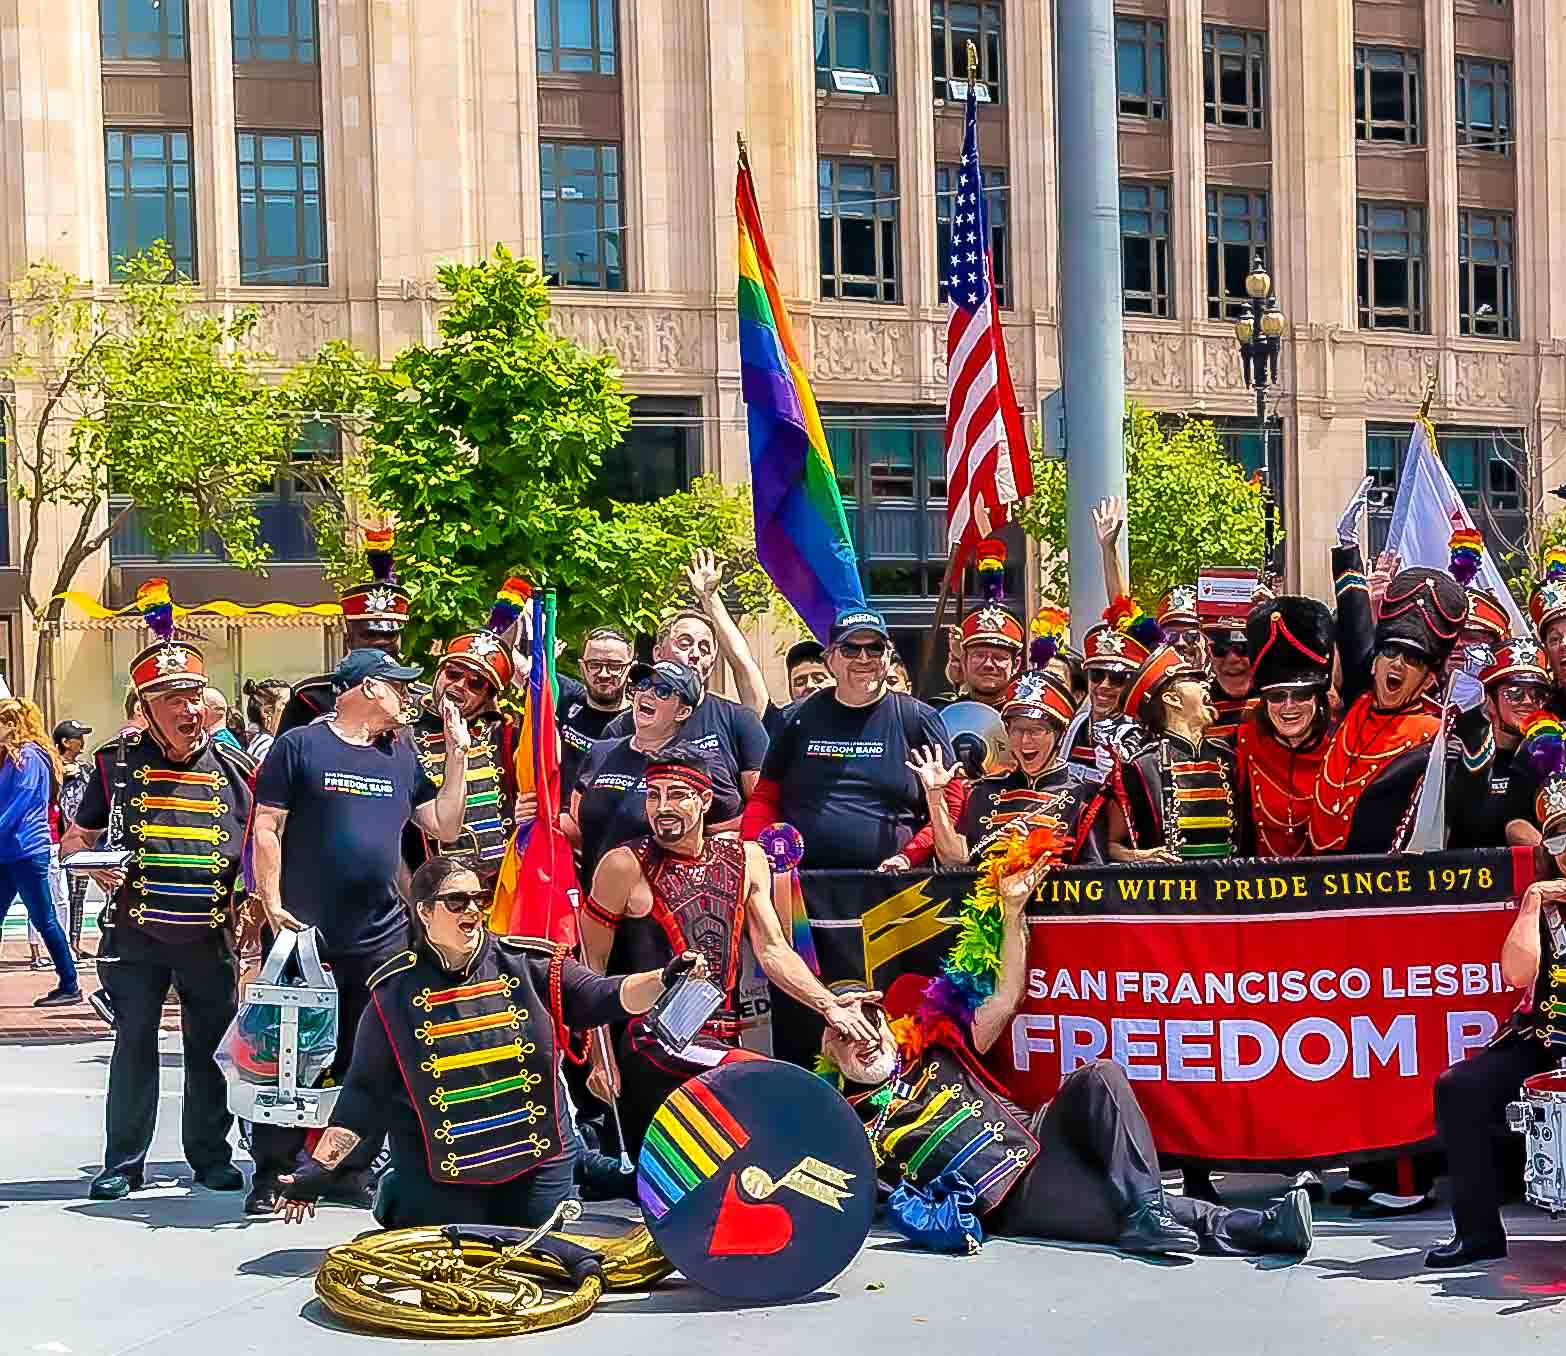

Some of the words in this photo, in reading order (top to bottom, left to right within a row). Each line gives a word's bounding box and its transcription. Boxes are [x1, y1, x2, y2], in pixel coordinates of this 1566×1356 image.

[807, 745, 854, 753] FREEDOM
[856, 745, 884, 754] BAND
[1118, 879, 1200, 902] WITH
[1214, 875, 1309, 902] PRIDE
[1322, 869, 1412, 896] SINCE
[1427, 867, 1494, 892] 1978
[1027, 968, 1107, 1001] SAN
[1115, 967, 1371, 1005] FRANCISCO
[1381, 961, 1515, 999] LESBI
[1012, 1013, 1420, 1082] FREEDOM
